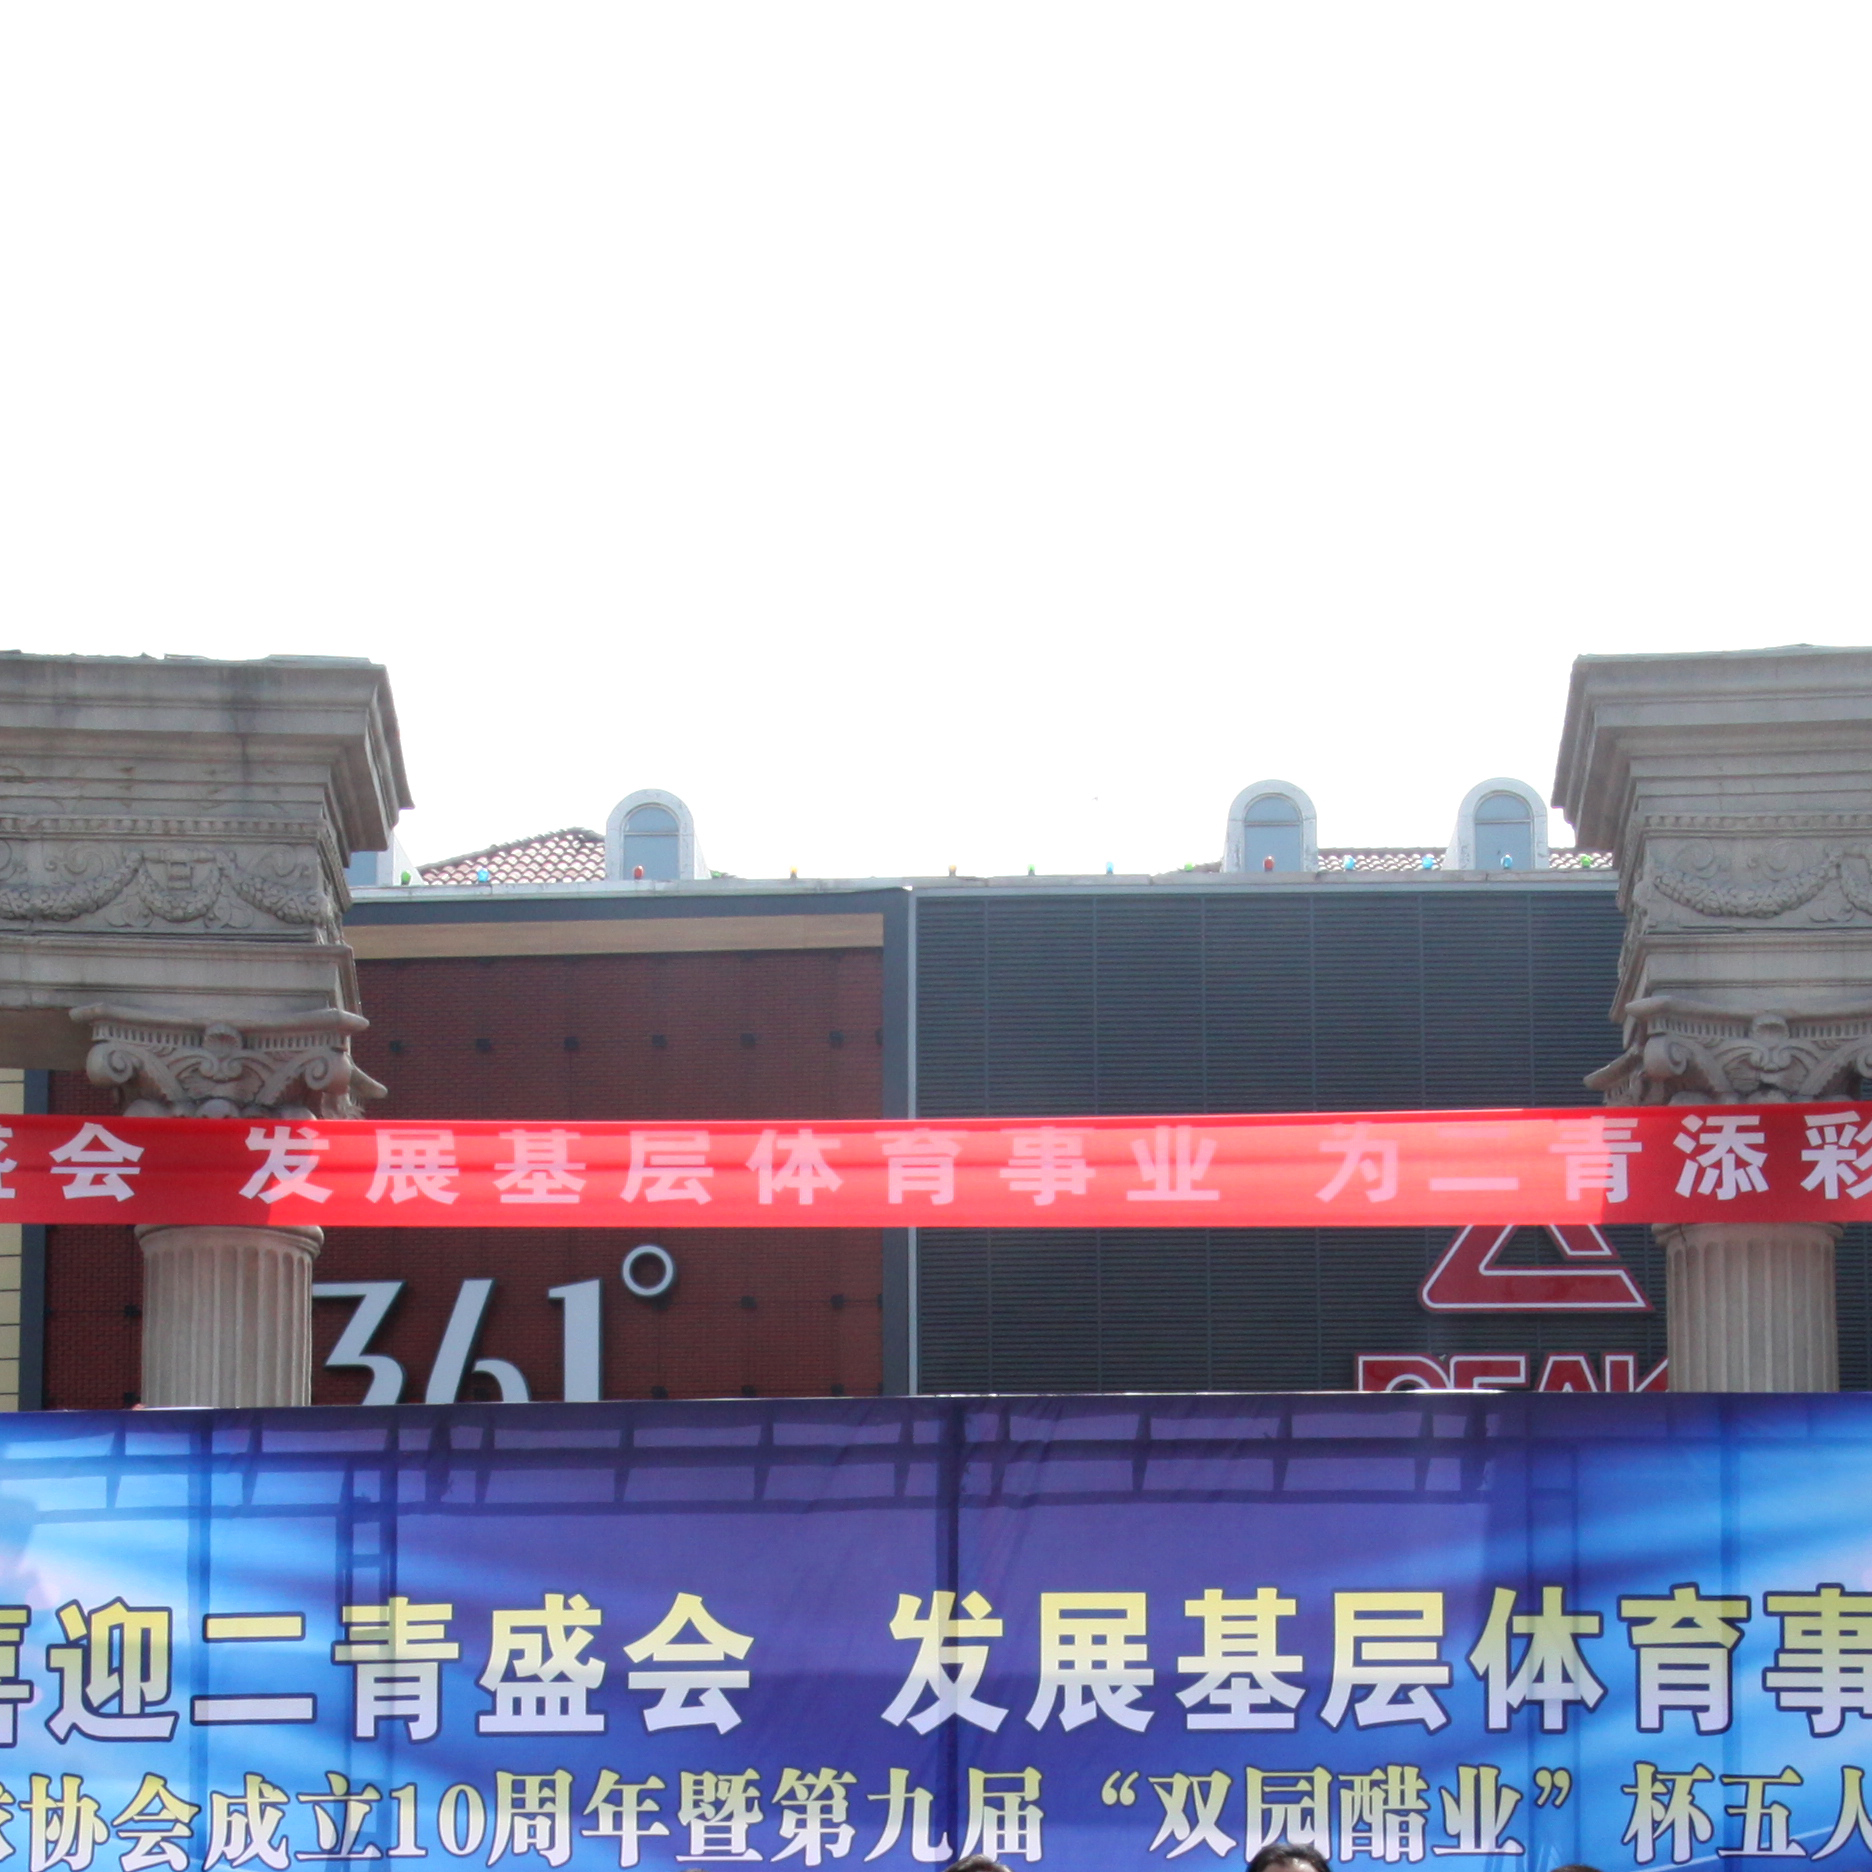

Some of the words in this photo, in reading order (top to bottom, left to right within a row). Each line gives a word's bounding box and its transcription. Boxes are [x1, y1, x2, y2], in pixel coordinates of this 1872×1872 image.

[236, 1124, 1222, 1208] 发展基层体育事业
